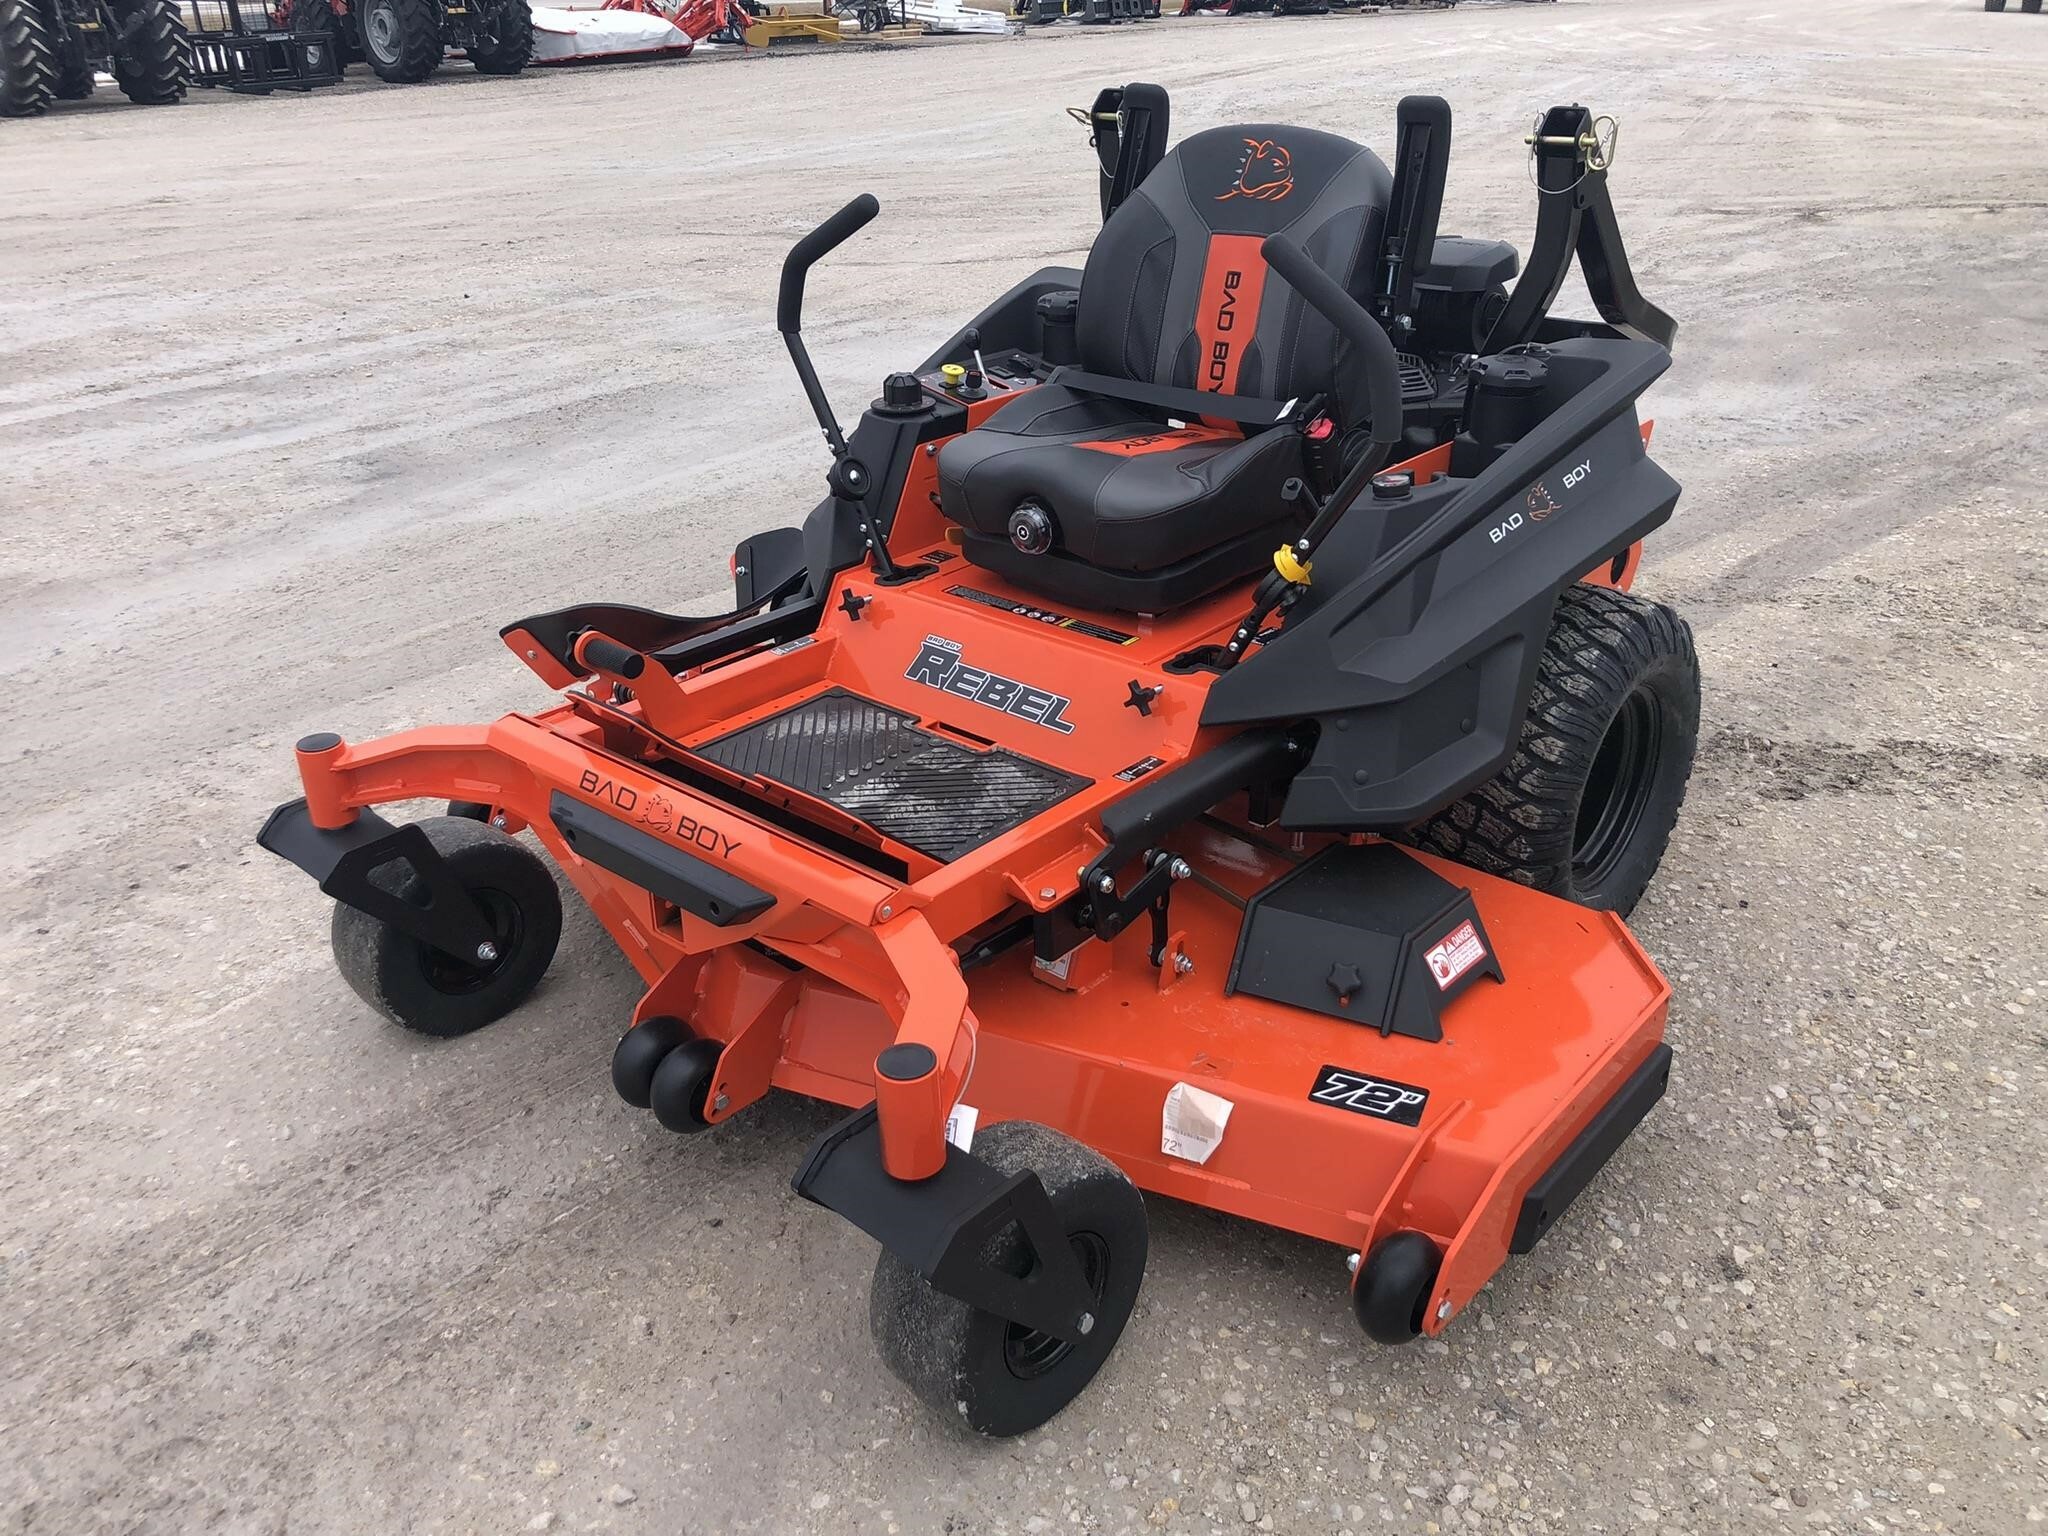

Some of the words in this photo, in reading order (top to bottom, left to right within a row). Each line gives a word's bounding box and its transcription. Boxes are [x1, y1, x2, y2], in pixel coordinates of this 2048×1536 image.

[1217, 270, 1242, 331] BAD
[1488, 512, 1523, 544] BAD
[1562, 459, 1591, 489] BOY
[926, 634, 945, 646] BAD
[943, 639, 963, 651] BOY
[903, 640, 1076, 735] REBEL
[578, 769, 637, 811] BAD
[676, 815, 742, 859] BOY
